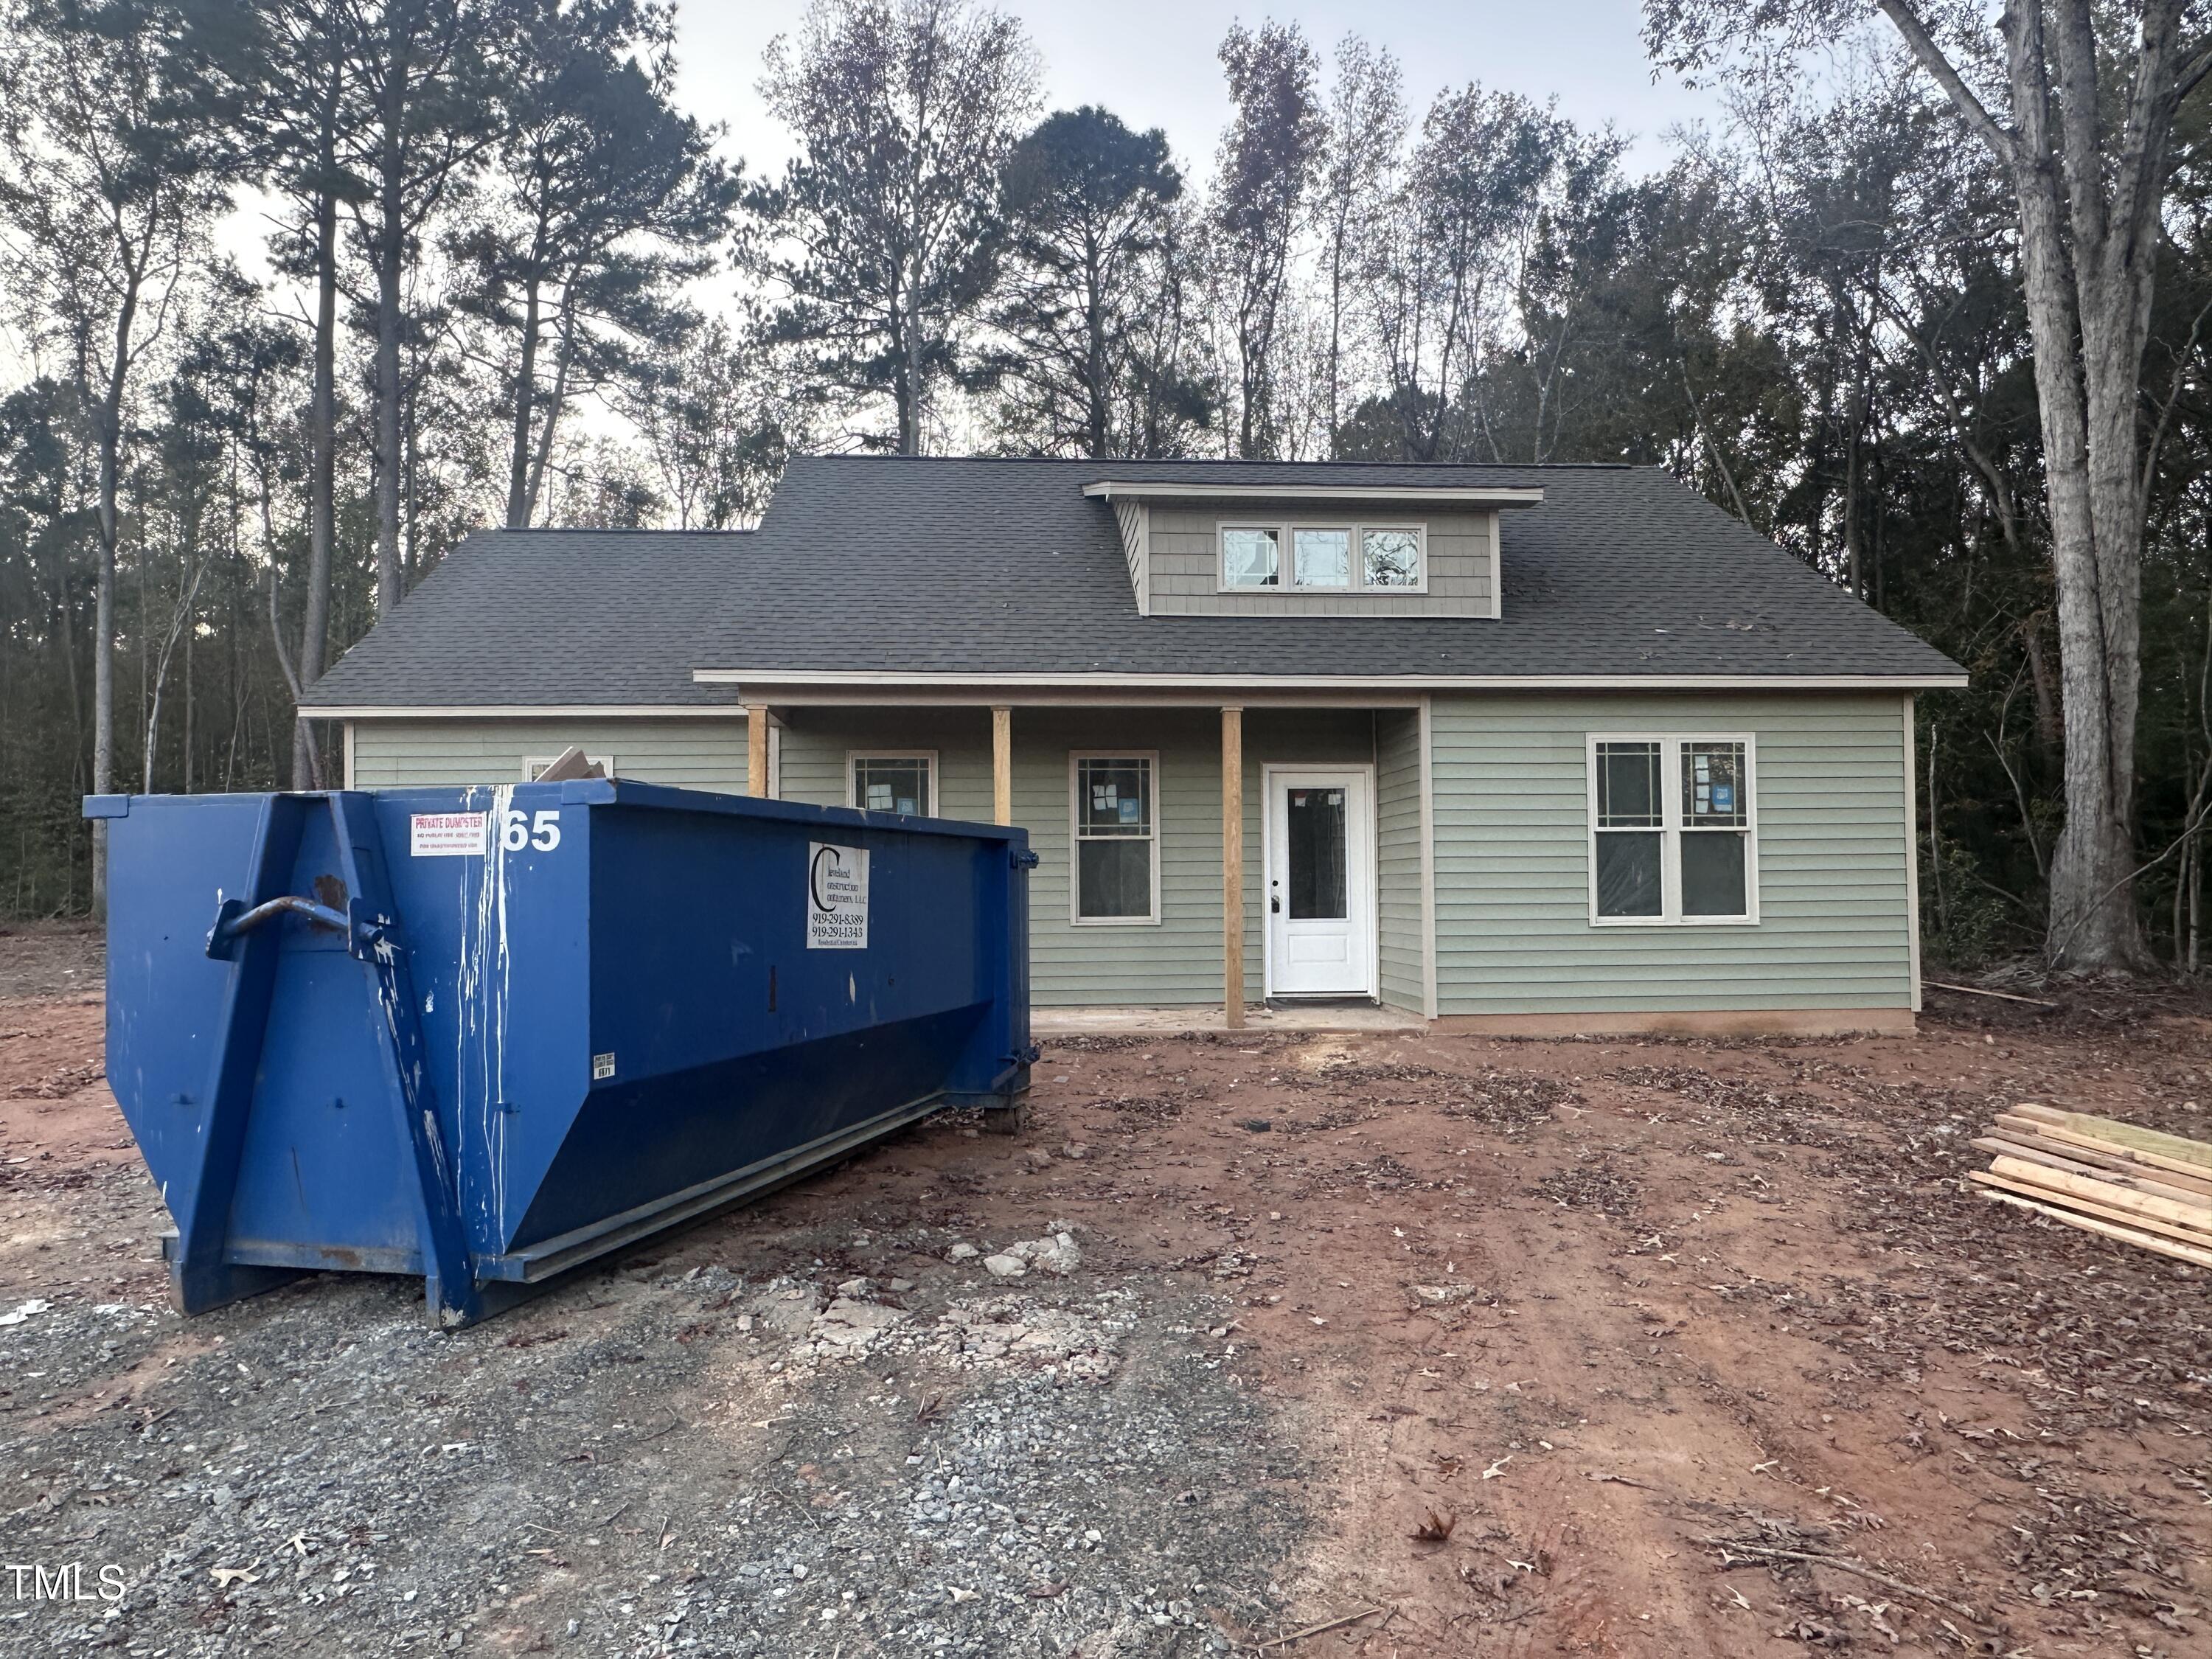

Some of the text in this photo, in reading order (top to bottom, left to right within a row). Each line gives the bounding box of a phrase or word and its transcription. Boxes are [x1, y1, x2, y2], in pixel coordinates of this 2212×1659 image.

[416, 816, 483, 829] PRIVATE DUMPSTER
[504, 810, 561, 852] 65
